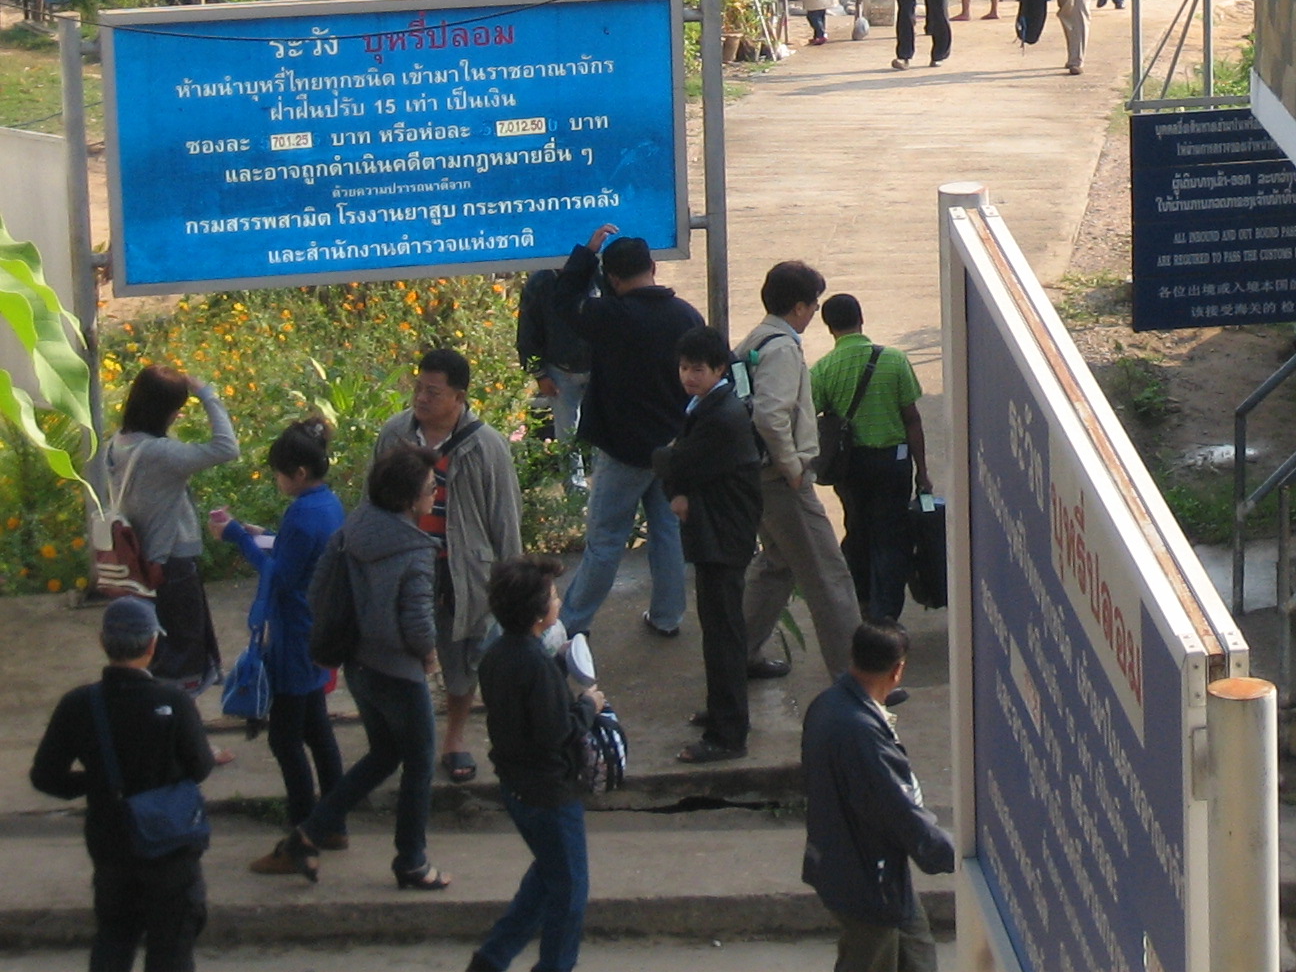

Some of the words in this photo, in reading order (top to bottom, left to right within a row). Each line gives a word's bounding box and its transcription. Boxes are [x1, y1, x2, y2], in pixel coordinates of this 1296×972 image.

[269, 26, 340, 59] ระวัง
[363, 10, 515, 64] บุหรี่ปลอม
[175, 66, 396, 102] ห้ามนำบุหรี่ไทยทุกชนิด
[402, 53, 615, 85] เข้ามาในราชอาณาจักร
[269, 92, 365, 121] ฝ่าฝืนปรับ
[375, 98, 396, 115] 15
[405, 92, 438, 113] เท่า
[446, 86, 517, 111] เป็นเงิน
[185, 137, 251, 155] ซองละ
[271, 135, 309, 149] 701.25
[331, 129, 371, 146] บาท
[379, 121, 471, 144] หรือห่อละ
[568, 114, 609, 132] บาท
[185, 205, 331, 235] กรมสรรพสามิต
[336, 202, 456, 226] โรงงานยาสูบ
[463, 187, 621, 218] กระทรวงการคลัง
[268, 227, 535, 265] และสำนักงานตำรวจแห่งชาติ
[1173, 232, 1187, 244] ALL
[1188, 230, 1220, 243] INBOUND
[1221, 229, 1237, 242] AND
[1238, 228, 1253, 241] OUT
[1255, 226, 1280, 240] BOUND
[1156, 255, 1172, 267] ARE
[1211, 252, 1222, 264] TO
[1223, 250, 1241, 263] PASS
[1243, 249, 1258, 262] THE
[1259, 247, 1293, 261] CUSTOMS
